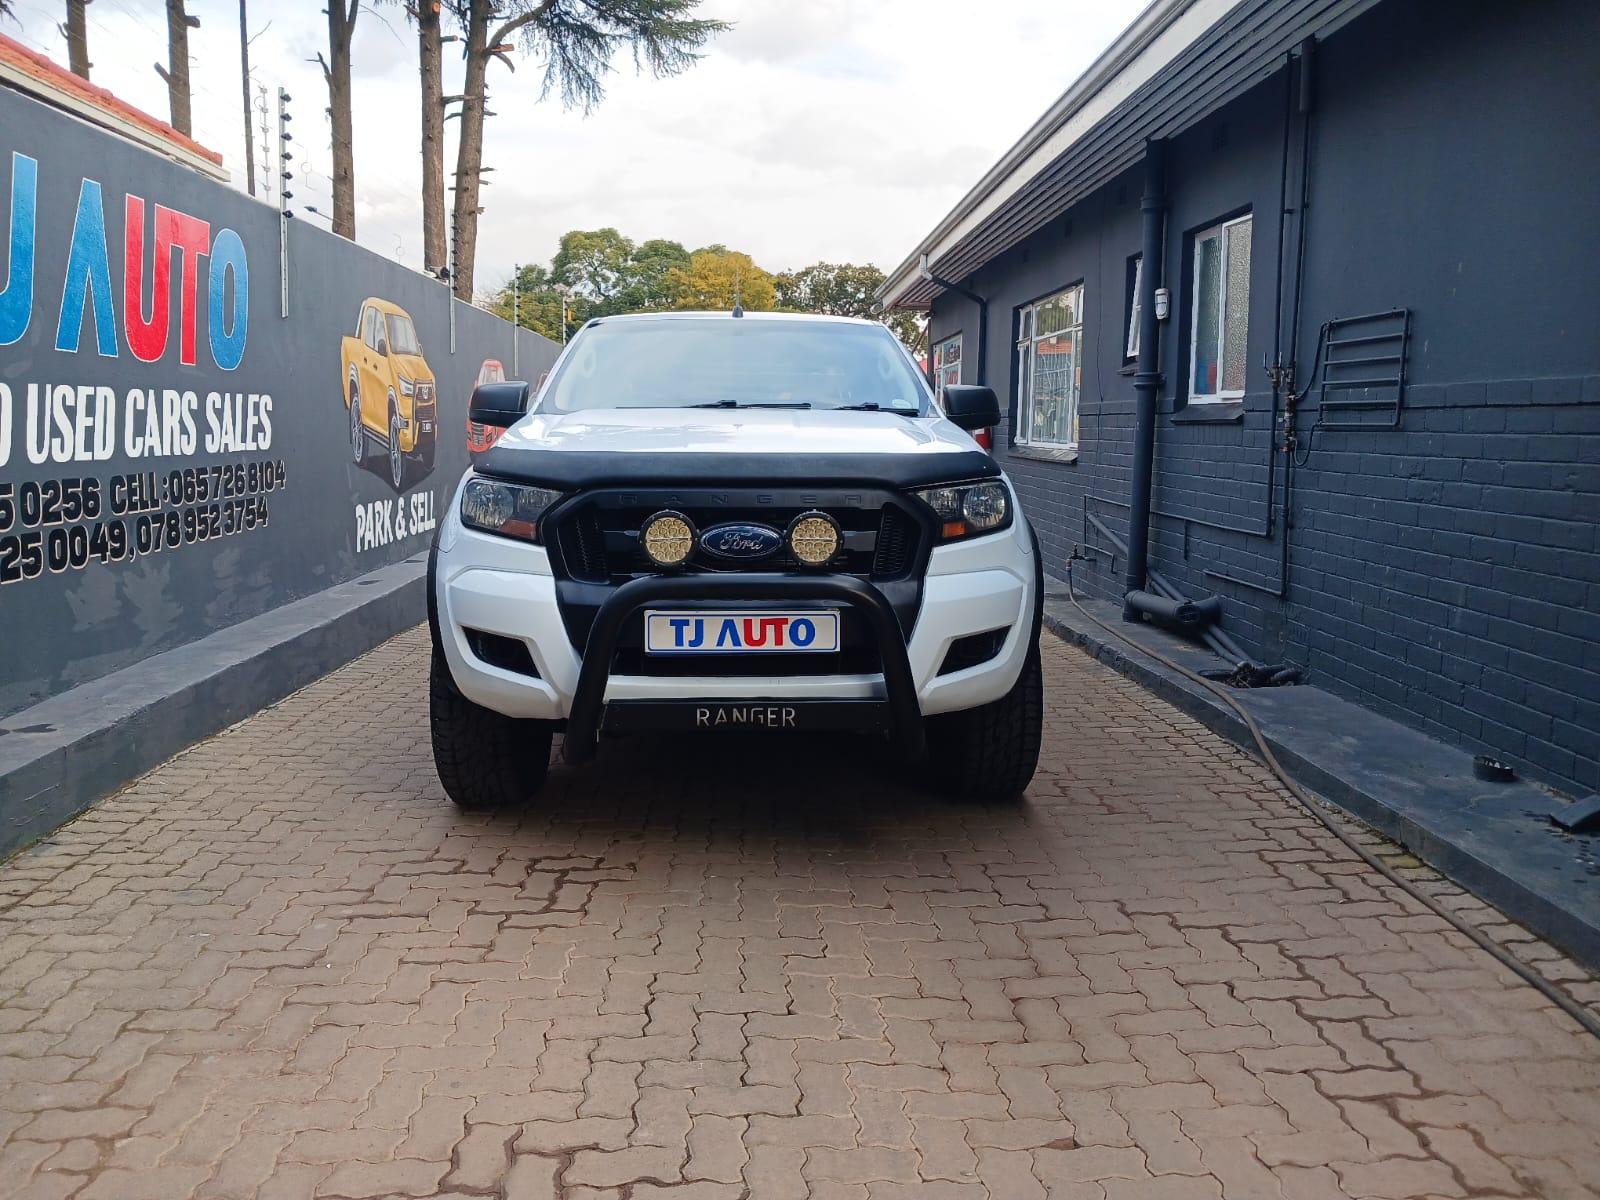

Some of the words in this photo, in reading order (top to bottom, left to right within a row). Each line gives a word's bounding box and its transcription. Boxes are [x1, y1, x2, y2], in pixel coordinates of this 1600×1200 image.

[55, 178, 248, 371] AUTO
[26, 383, 115, 464] USED
[125, 388, 198, 457] CARS
[205, 391, 272, 453] SALES
[20, 477, 100, 527] 0256
[356, 501, 394, 552] PARK
[395, 496, 407, 540] &
[410, 491, 435, 536] SELL
[719, 531, 764, 550] Ford
[669, 618, 704, 647] TJ
[716, 617, 816, 647] AUTO
[696, 707, 796, 727] RANGER
